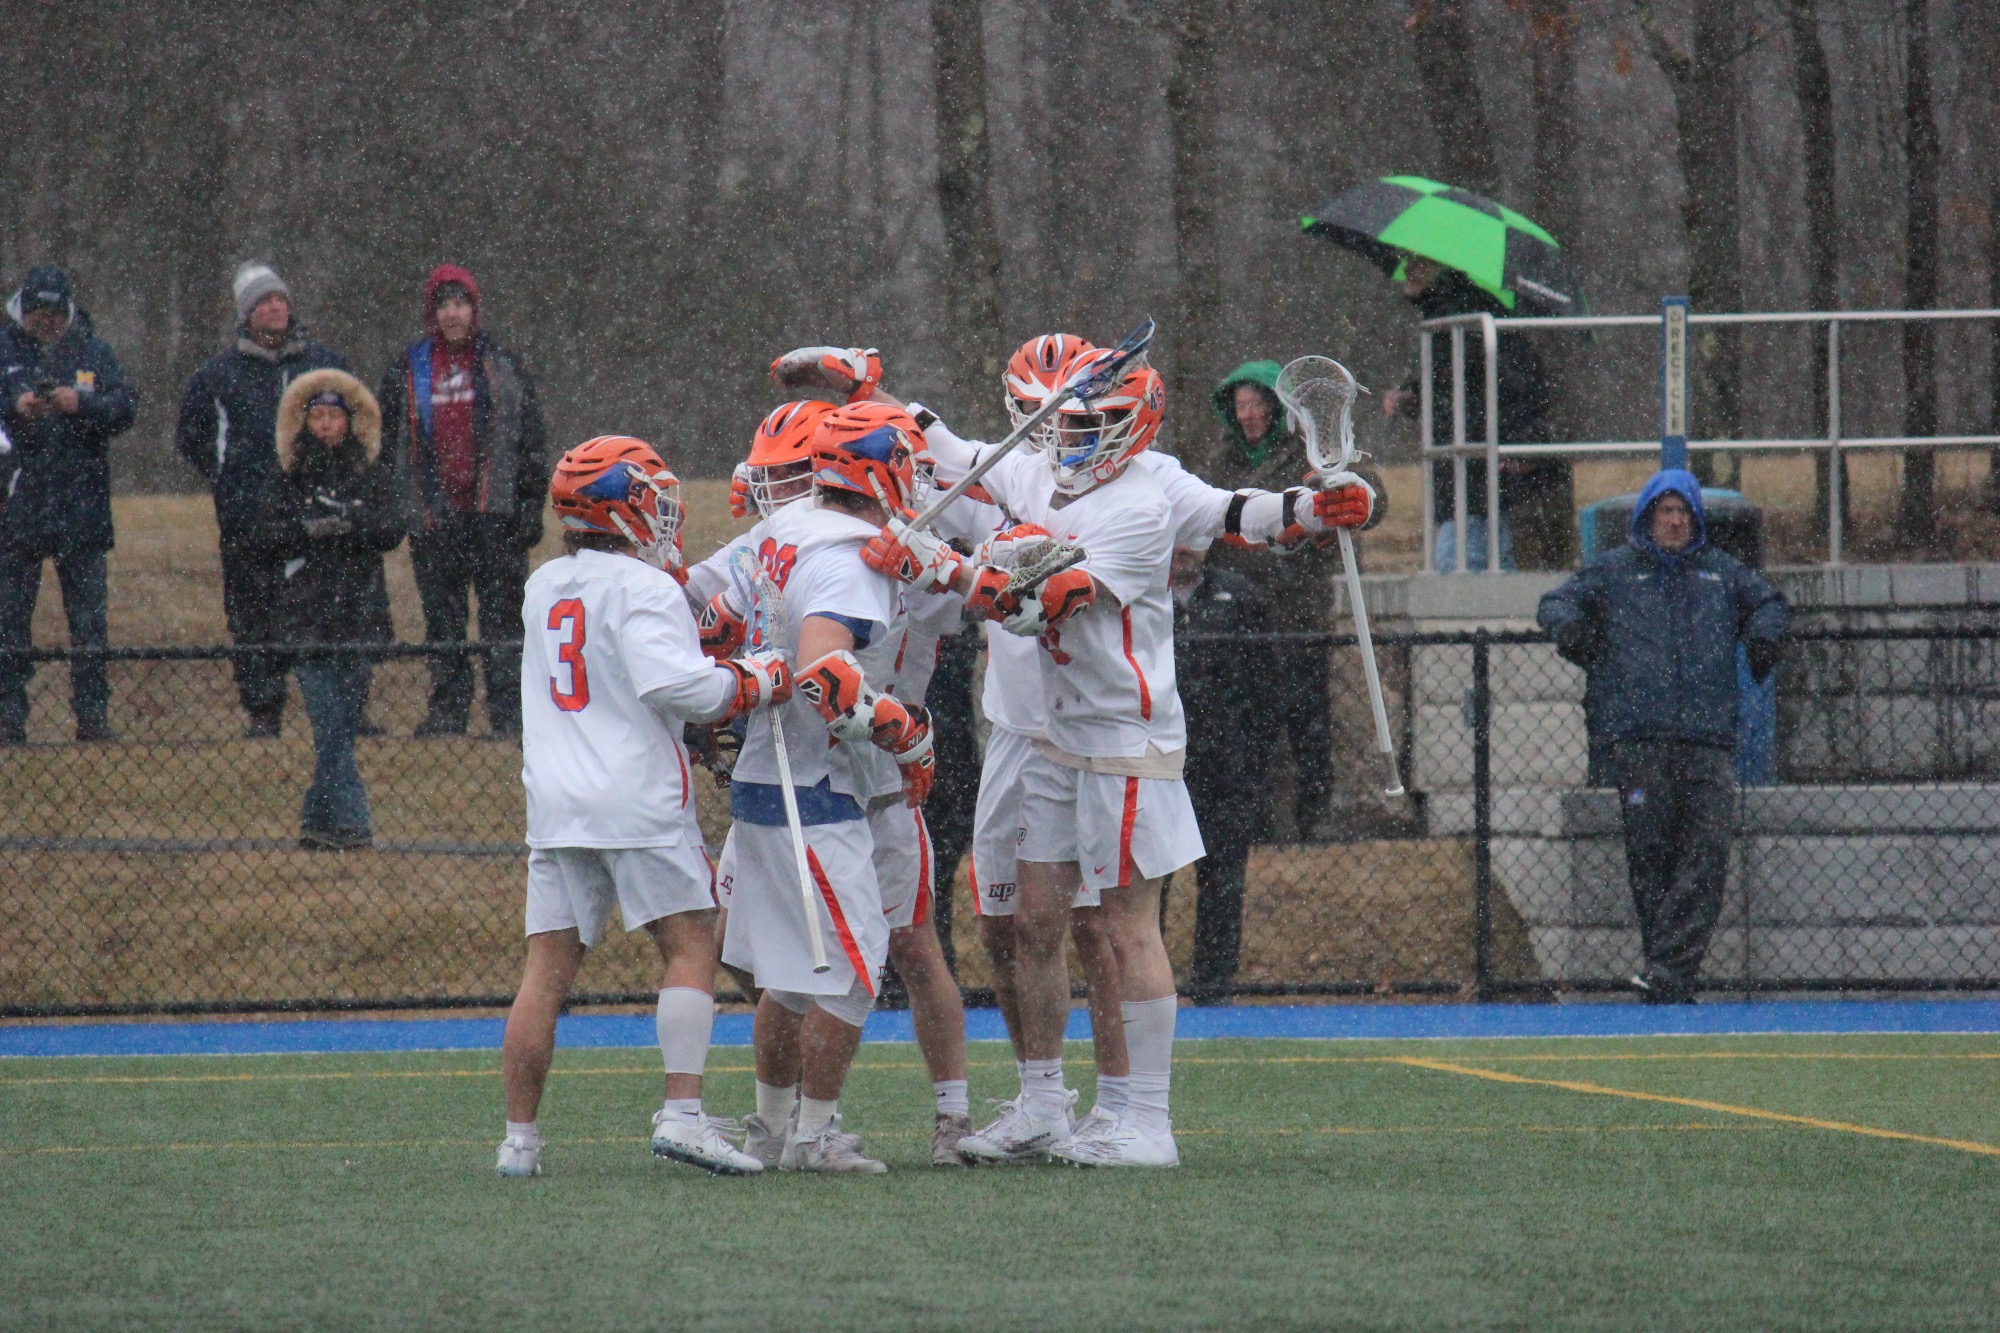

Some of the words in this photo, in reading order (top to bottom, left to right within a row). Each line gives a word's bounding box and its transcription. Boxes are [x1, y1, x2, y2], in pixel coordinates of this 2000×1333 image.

[1149, 383, 1164, 411] 45
[928, 543, 950, 573] STX
[980, 542, 990, 564] TX
[547, 597, 591, 712] 3
[988, 882, 1016, 902] NP
